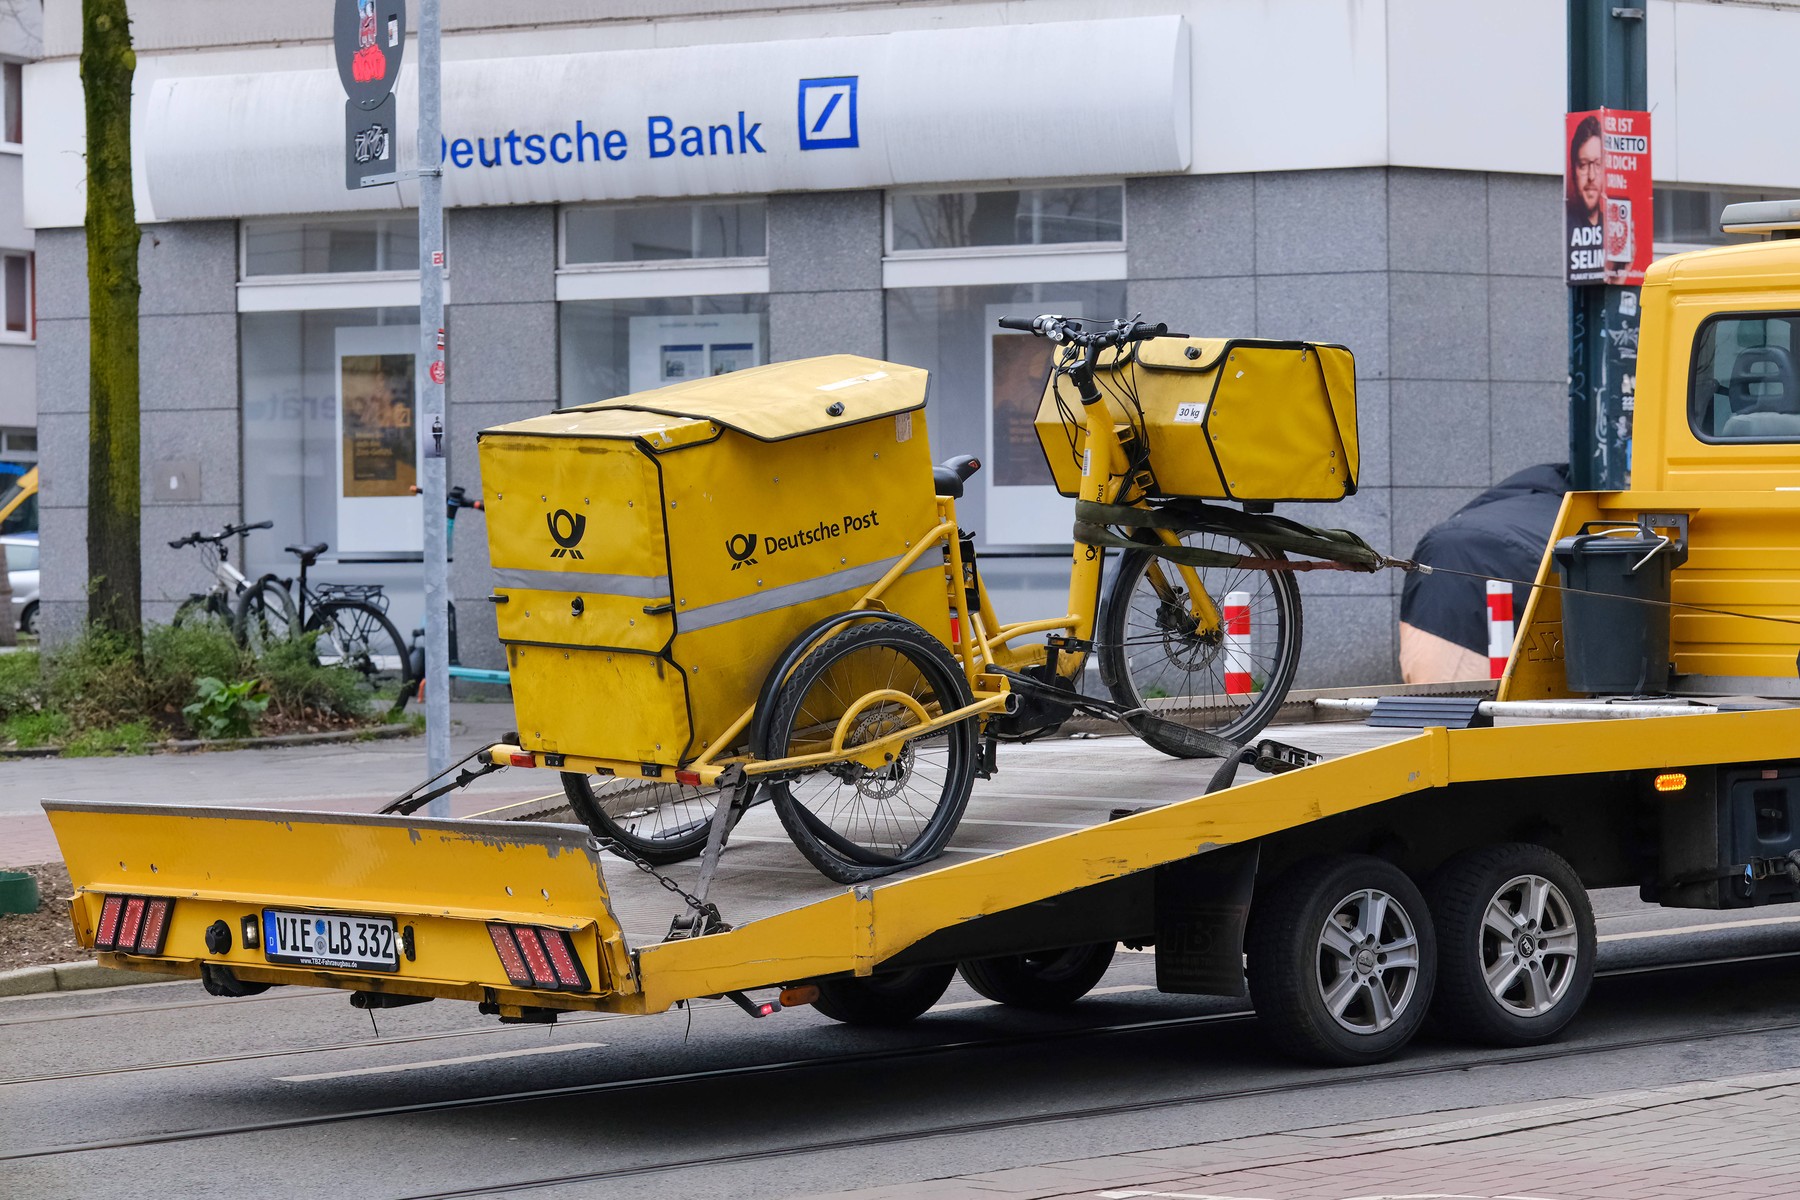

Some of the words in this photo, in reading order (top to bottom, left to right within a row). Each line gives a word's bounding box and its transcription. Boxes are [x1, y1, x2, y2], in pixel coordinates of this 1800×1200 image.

[1618, 118, 1634, 133] IST
[441, 120, 627, 169] eutsche
[648, 111, 766, 159] Bank
[1613, 138, 1645, 152] NETTO
[1613, 155, 1637, 171] DICH
[1571, 226, 1603, 247] ADIS
[1178, 408, 1190, 417] 30
[1190, 407, 1200, 419] kg
[1096, 484, 1105, 502] Post
[764, 521, 840, 555] Deutsche
[843, 510, 879, 534] Post
[269, 937, 274, 946] D
[276, 917, 313, 953] VIE
[327, 920, 352, 955] LB
[356, 923, 393, 959] 332
